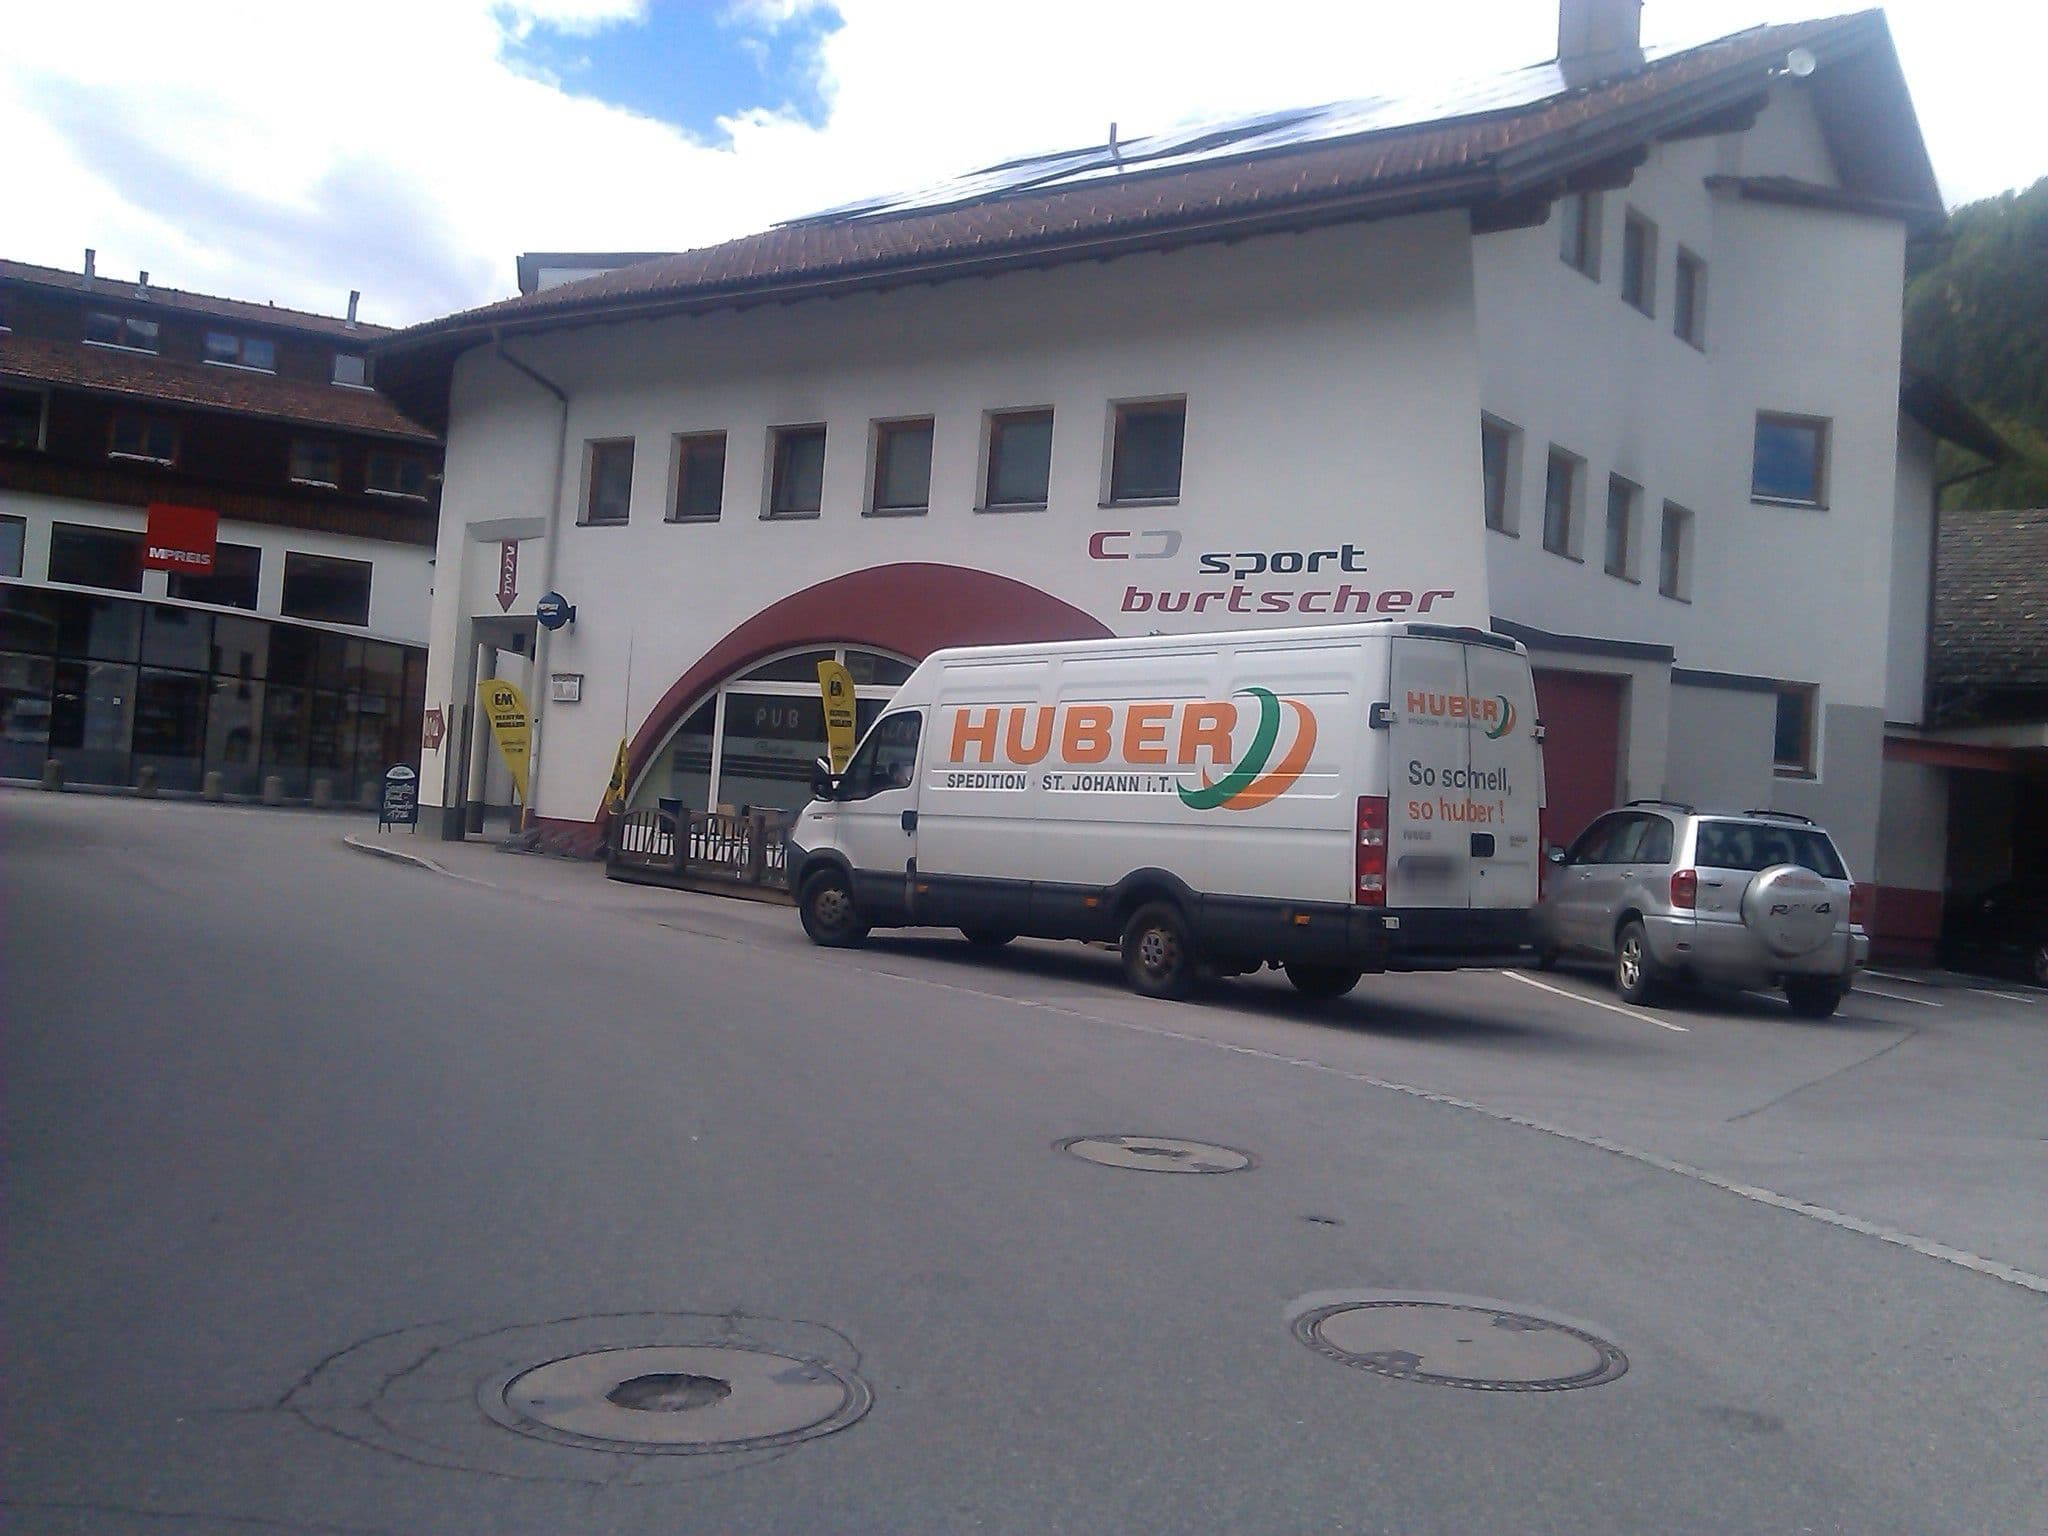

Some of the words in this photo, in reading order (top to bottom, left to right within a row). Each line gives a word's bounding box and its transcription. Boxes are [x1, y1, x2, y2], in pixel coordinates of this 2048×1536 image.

[149, 547, 211, 565] MPREIS
[1199, 544, 1368, 579] sport
[1120, 585, 1456, 613] burtscher
[756, 708, 800, 729] PUB
[1407, 691, 1498, 722] HUBER
[949, 701, 1238, 765] HUBER
[947, 773, 1026, 791] SPEDITION
[1042, 775, 1066, 792] ST.
[1072, 776, 1140, 793] JOHANN
[1408, 760, 1435, 787] So
[1441, 763, 1512, 796] schnell,
[1408, 802, 1434, 821] so
